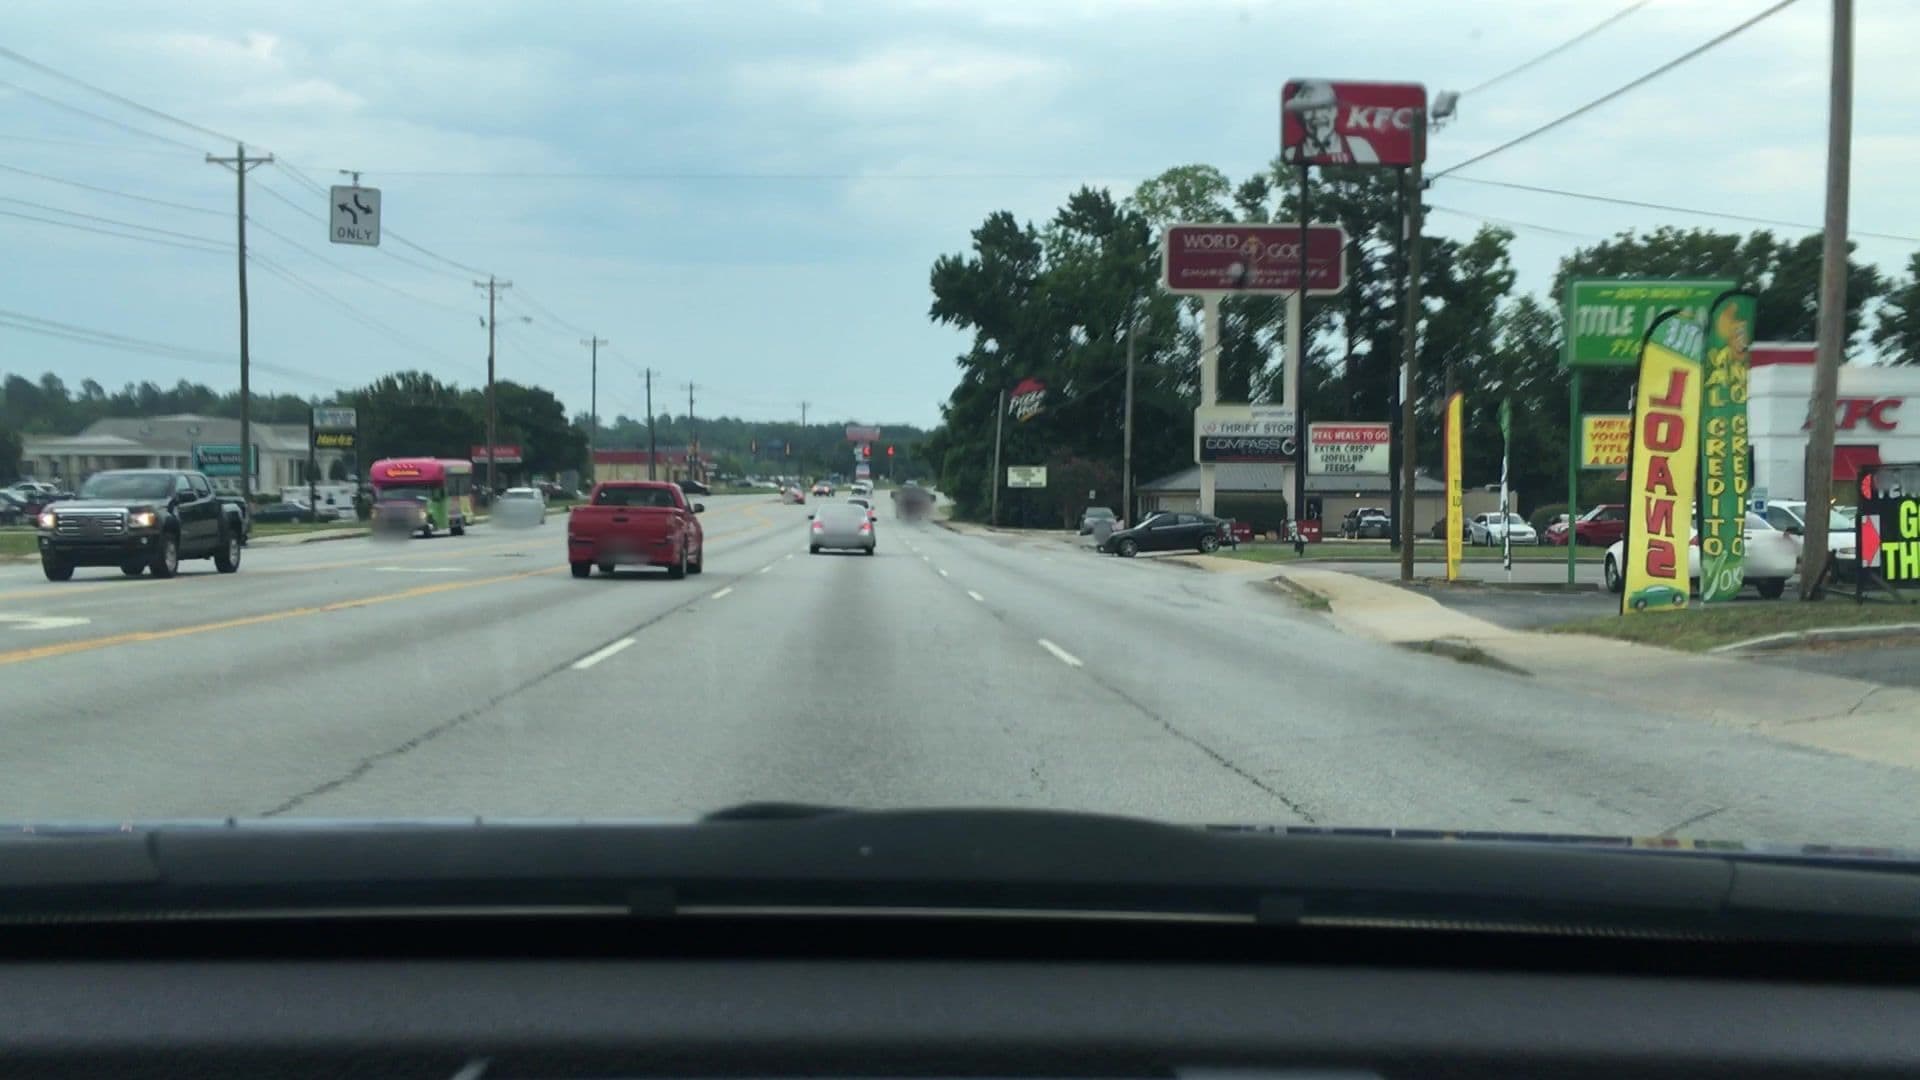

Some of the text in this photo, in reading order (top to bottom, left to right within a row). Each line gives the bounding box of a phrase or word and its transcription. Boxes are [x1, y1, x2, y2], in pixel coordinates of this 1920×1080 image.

[1346, 105, 1413, 129] KFC
[336, 226, 372, 241] ONLY
[1184, 234, 1239, 249] WORD
[1576, 305, 1635, 336] TITLE
[1220, 423, 1295, 434] THRIFT STOR
[1335, 431, 1361, 441] MEALS
[1363, 431, 1373, 441] TO
[1375, 431, 1388, 441] GO
[1589, 431, 1629, 442] YOUR
[1206, 440, 1280, 450] COMPASS
[1314, 443, 1375, 454] EXTRA CRISPY
[1593, 444, 1628, 453] TITL
[1590, 456, 1628, 465] A LO
[1703, 417, 1728, 556] CREDITO
[1900, 500, 1920, 539] G
